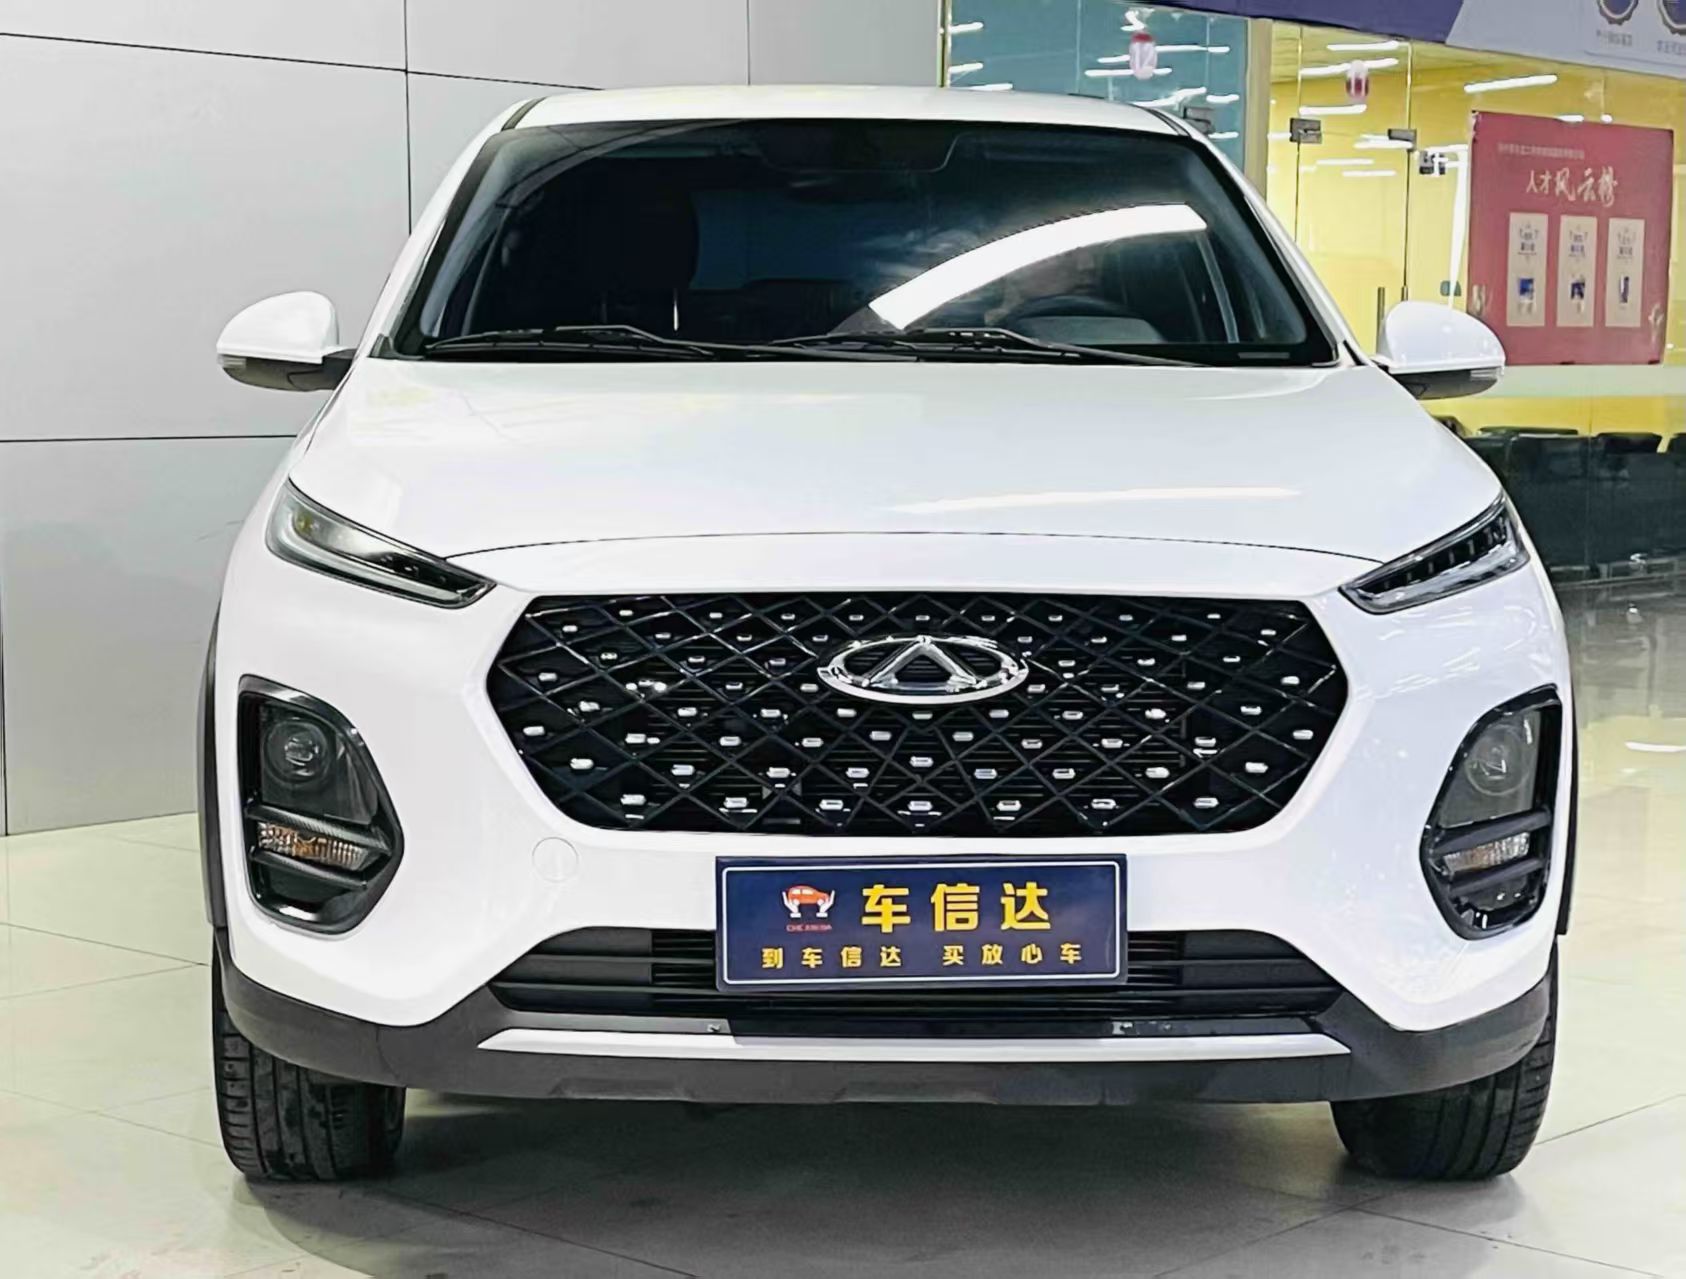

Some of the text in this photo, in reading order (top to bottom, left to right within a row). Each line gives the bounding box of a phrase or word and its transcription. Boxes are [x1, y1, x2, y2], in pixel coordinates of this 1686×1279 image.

[861, 881, 1051, 933] 车信达
[762, 942, 1082, 968] 到车信达 买放心车
